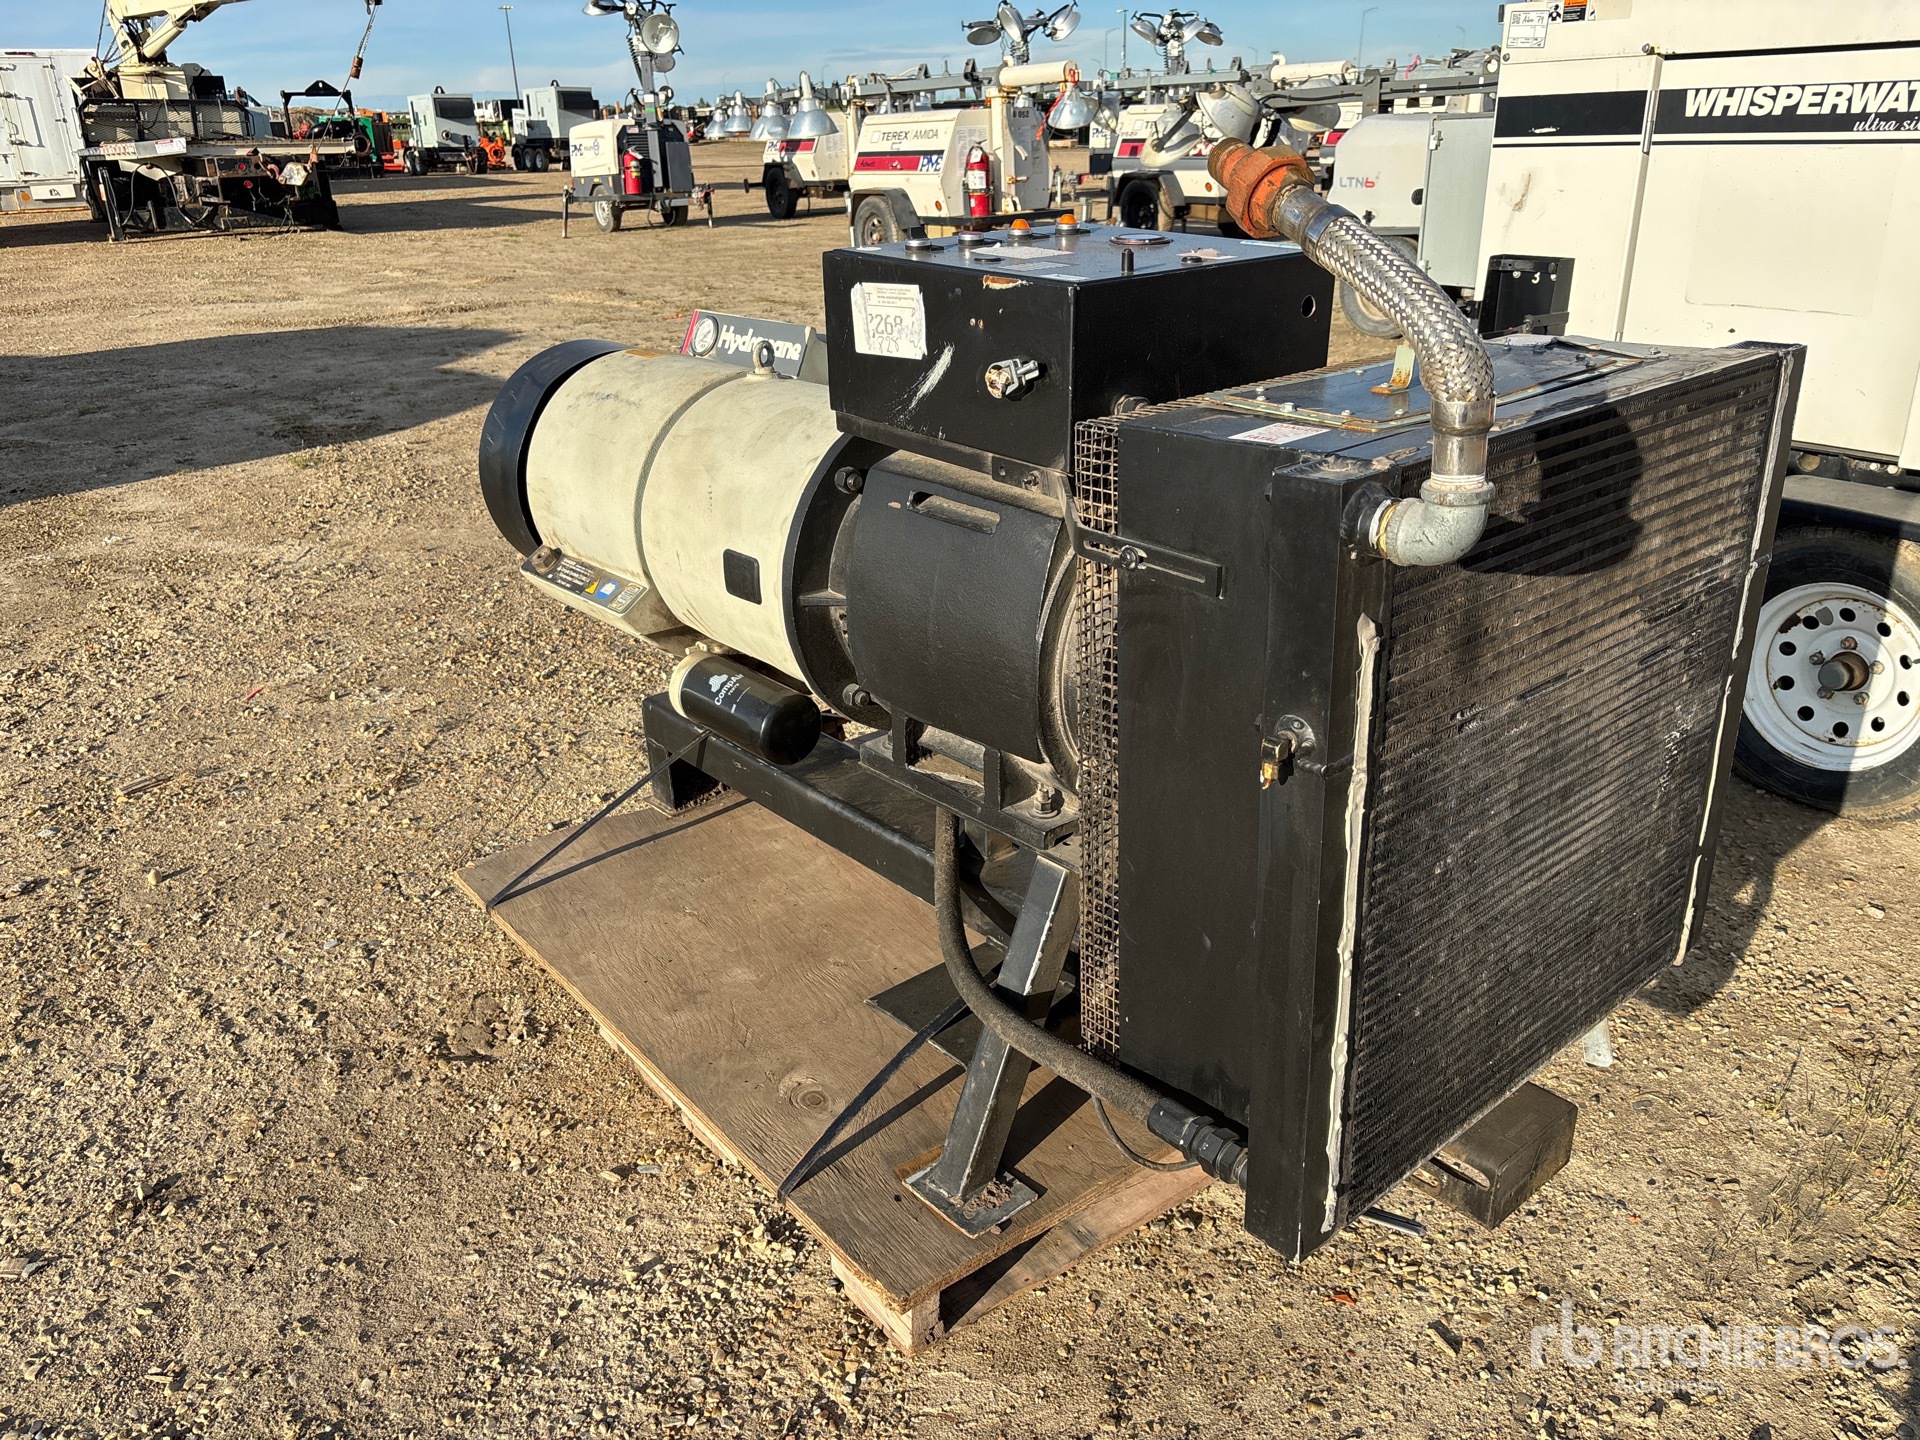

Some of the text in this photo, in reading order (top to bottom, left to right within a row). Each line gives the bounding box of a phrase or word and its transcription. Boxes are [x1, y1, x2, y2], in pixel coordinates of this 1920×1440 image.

[1853, 113, 1900, 131] ultra
[881, 129, 939, 142] TEREX AMIDA
[1339, 177, 1376, 188] LTN6
[717, 324, 803, 361] Hydrane
[714, 673, 745, 706] CompAir
